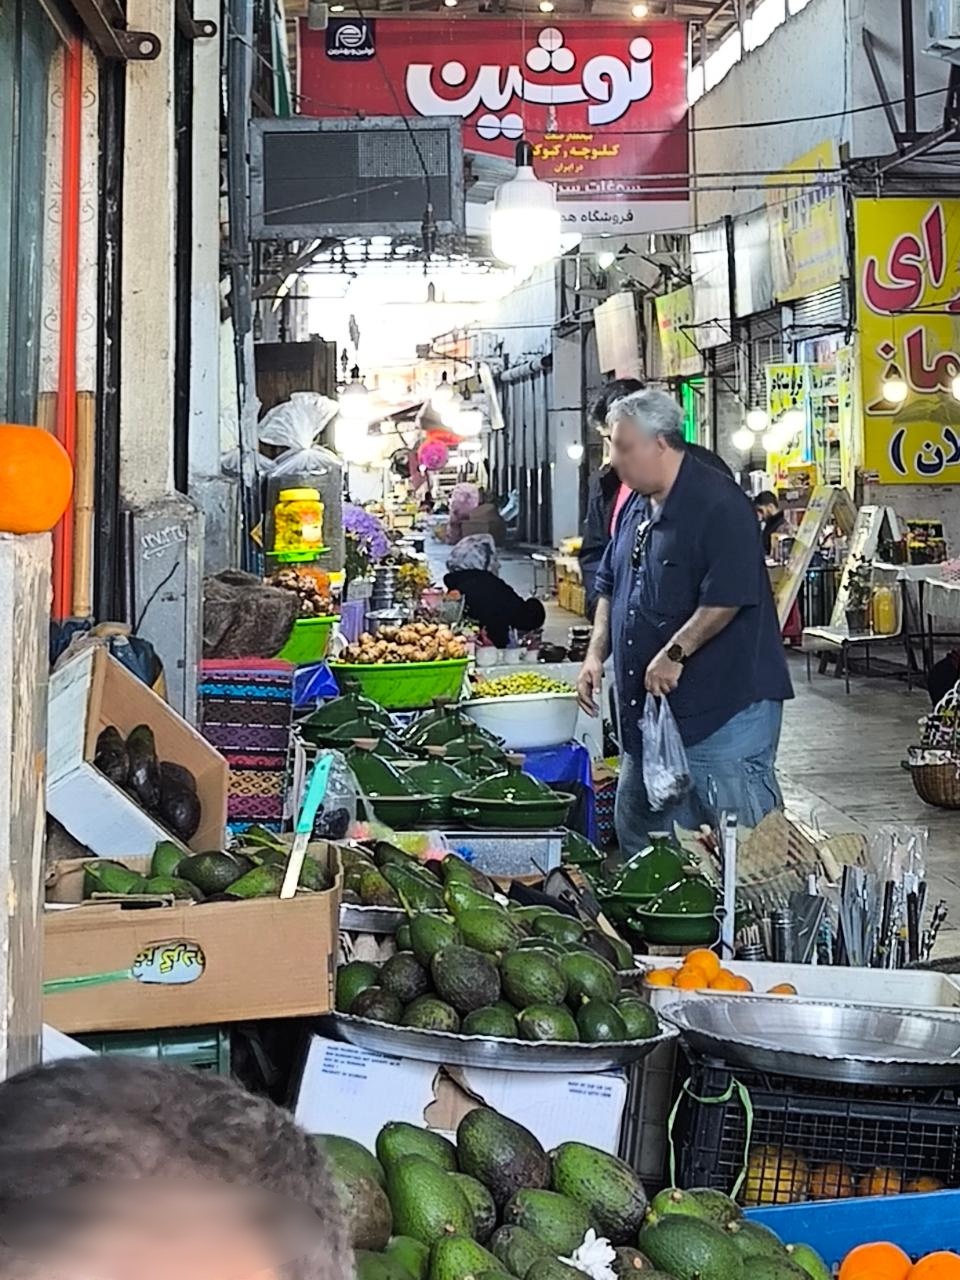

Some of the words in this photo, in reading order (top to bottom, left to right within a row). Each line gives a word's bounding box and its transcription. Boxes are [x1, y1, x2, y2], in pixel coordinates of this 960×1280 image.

[405, 27, 653, 140] نوشین
[569, 144, 620, 160] کلوچه
[580, 209, 634, 225] فروشگاه
